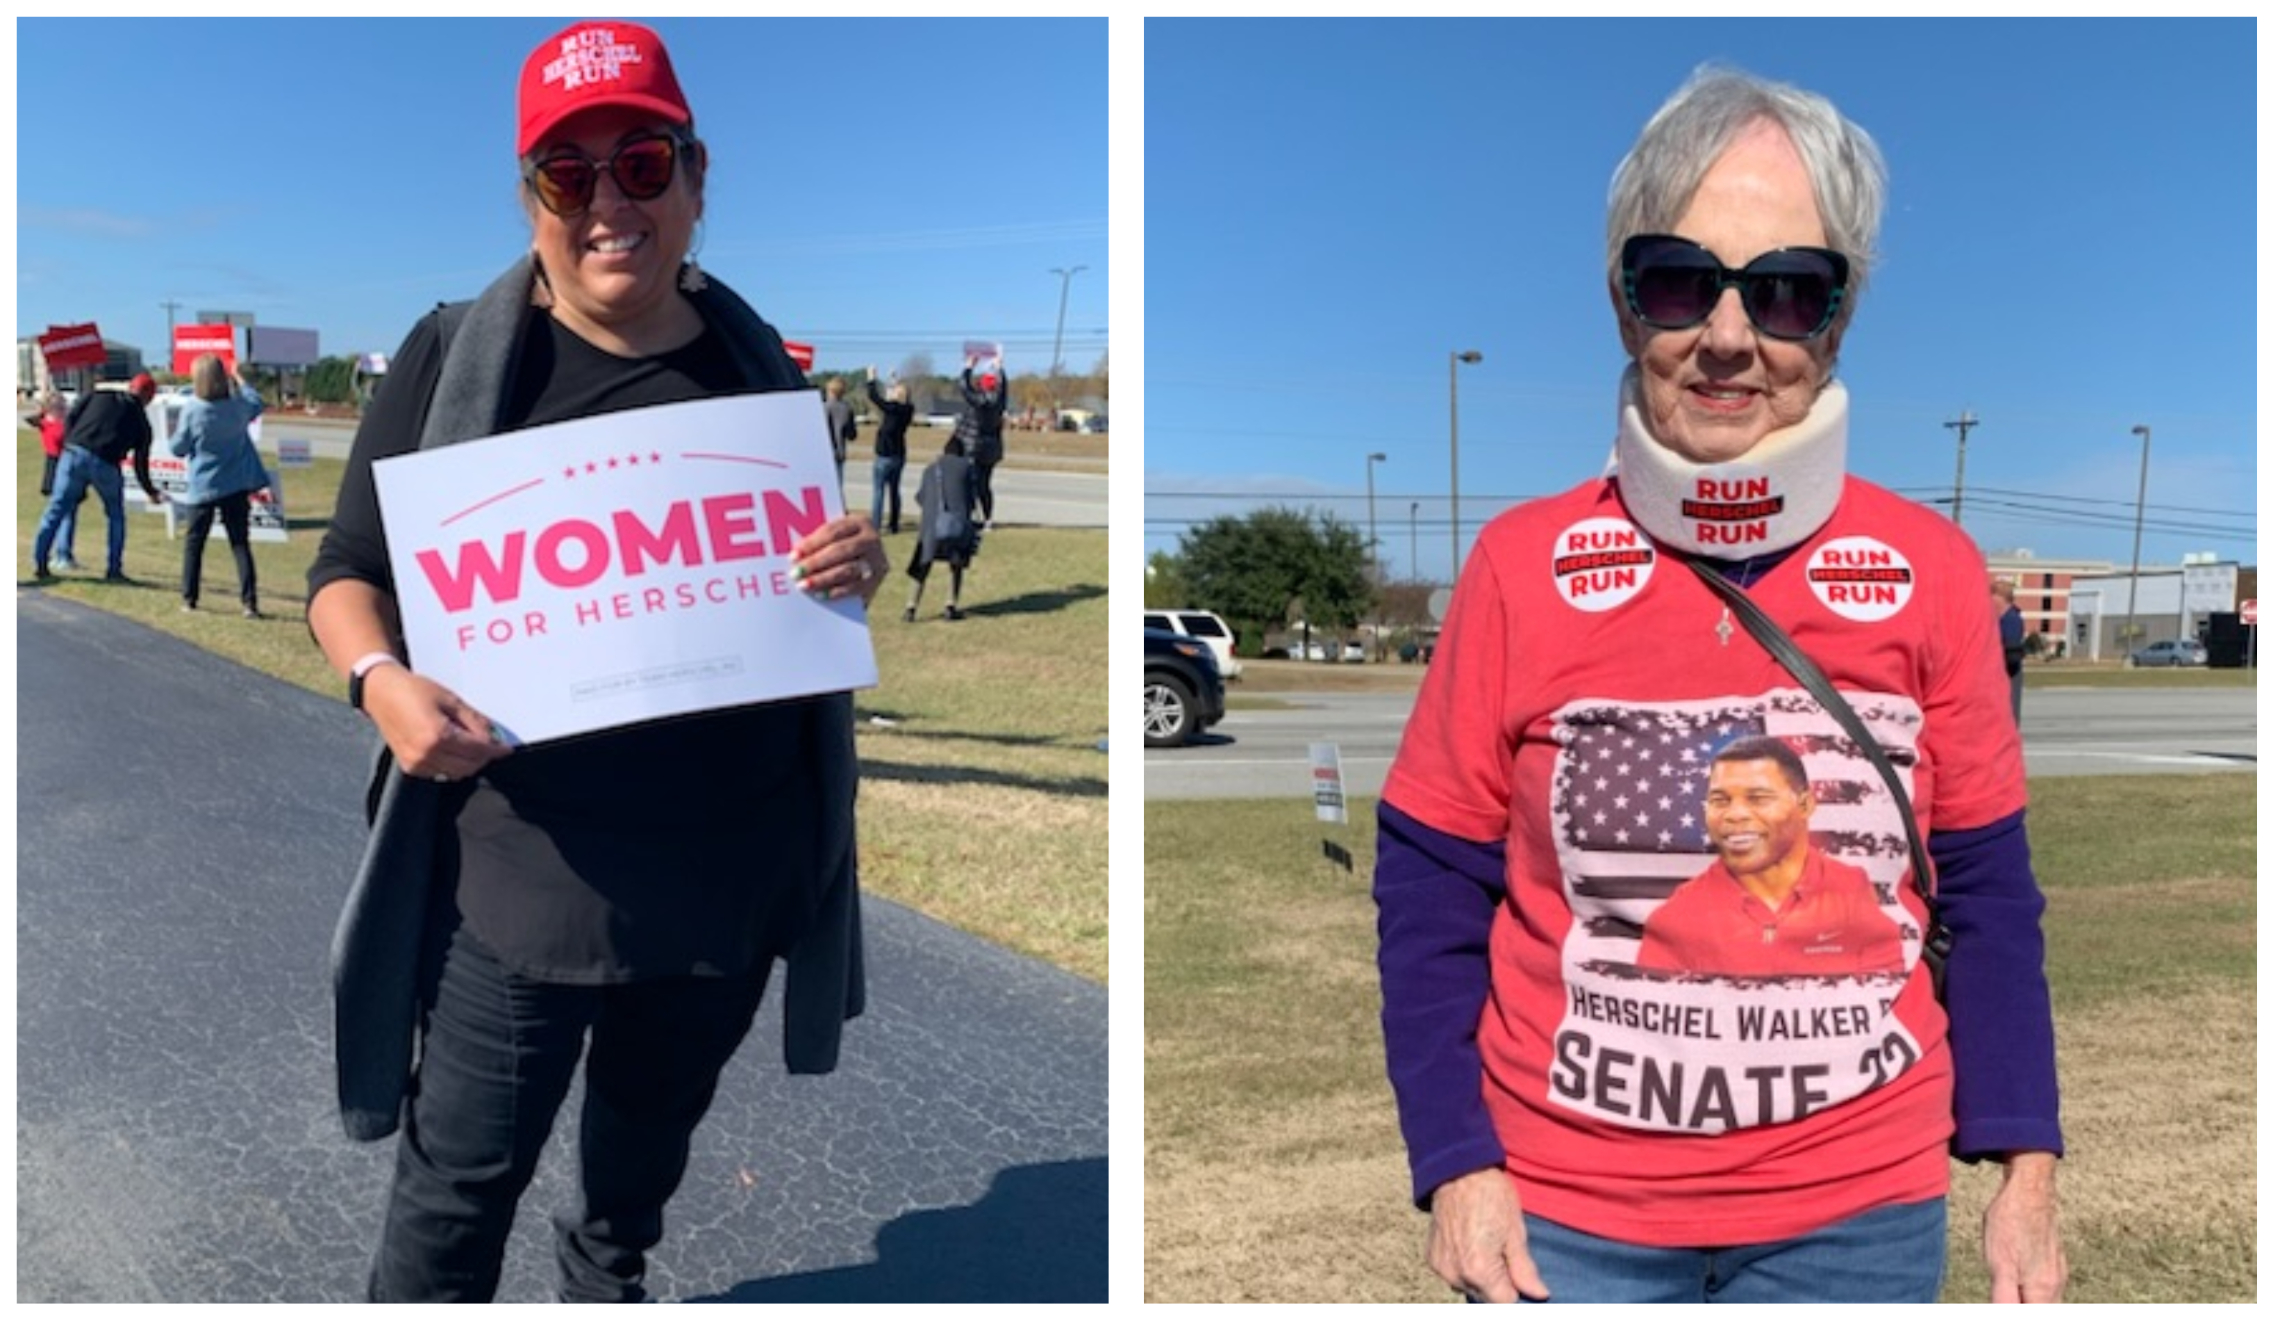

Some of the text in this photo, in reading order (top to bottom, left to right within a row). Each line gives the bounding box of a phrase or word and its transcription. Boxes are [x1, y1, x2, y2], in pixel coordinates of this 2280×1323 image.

[561, 30, 615, 55] RUN
[564, 59, 620, 91] RUN
[1697, 476, 1768, 501] RUN
[1684, 498, 1781, 519] HERSCHEL
[1568, 530, 1636, 551] RUN
[1697, 520, 1766, 544] RUN
[415, 486, 828, 613] WOMEN
[1823, 550, 1890, 566] RUN
[1557, 551, 1650, 575] HERSCHEL
[1813, 569, 1906, 582] HERSCHEL
[1571, 568, 1636, 598] RUN
[1829, 585, 1896, 605] RUN
[457, 571, 790, 650] FOR HERSCHE
[1571, 984, 1722, 1040] HERSCHEL
[1737, 1004, 1870, 1042] WALKER
[1552, 1030, 1830, 1129] SENATE
